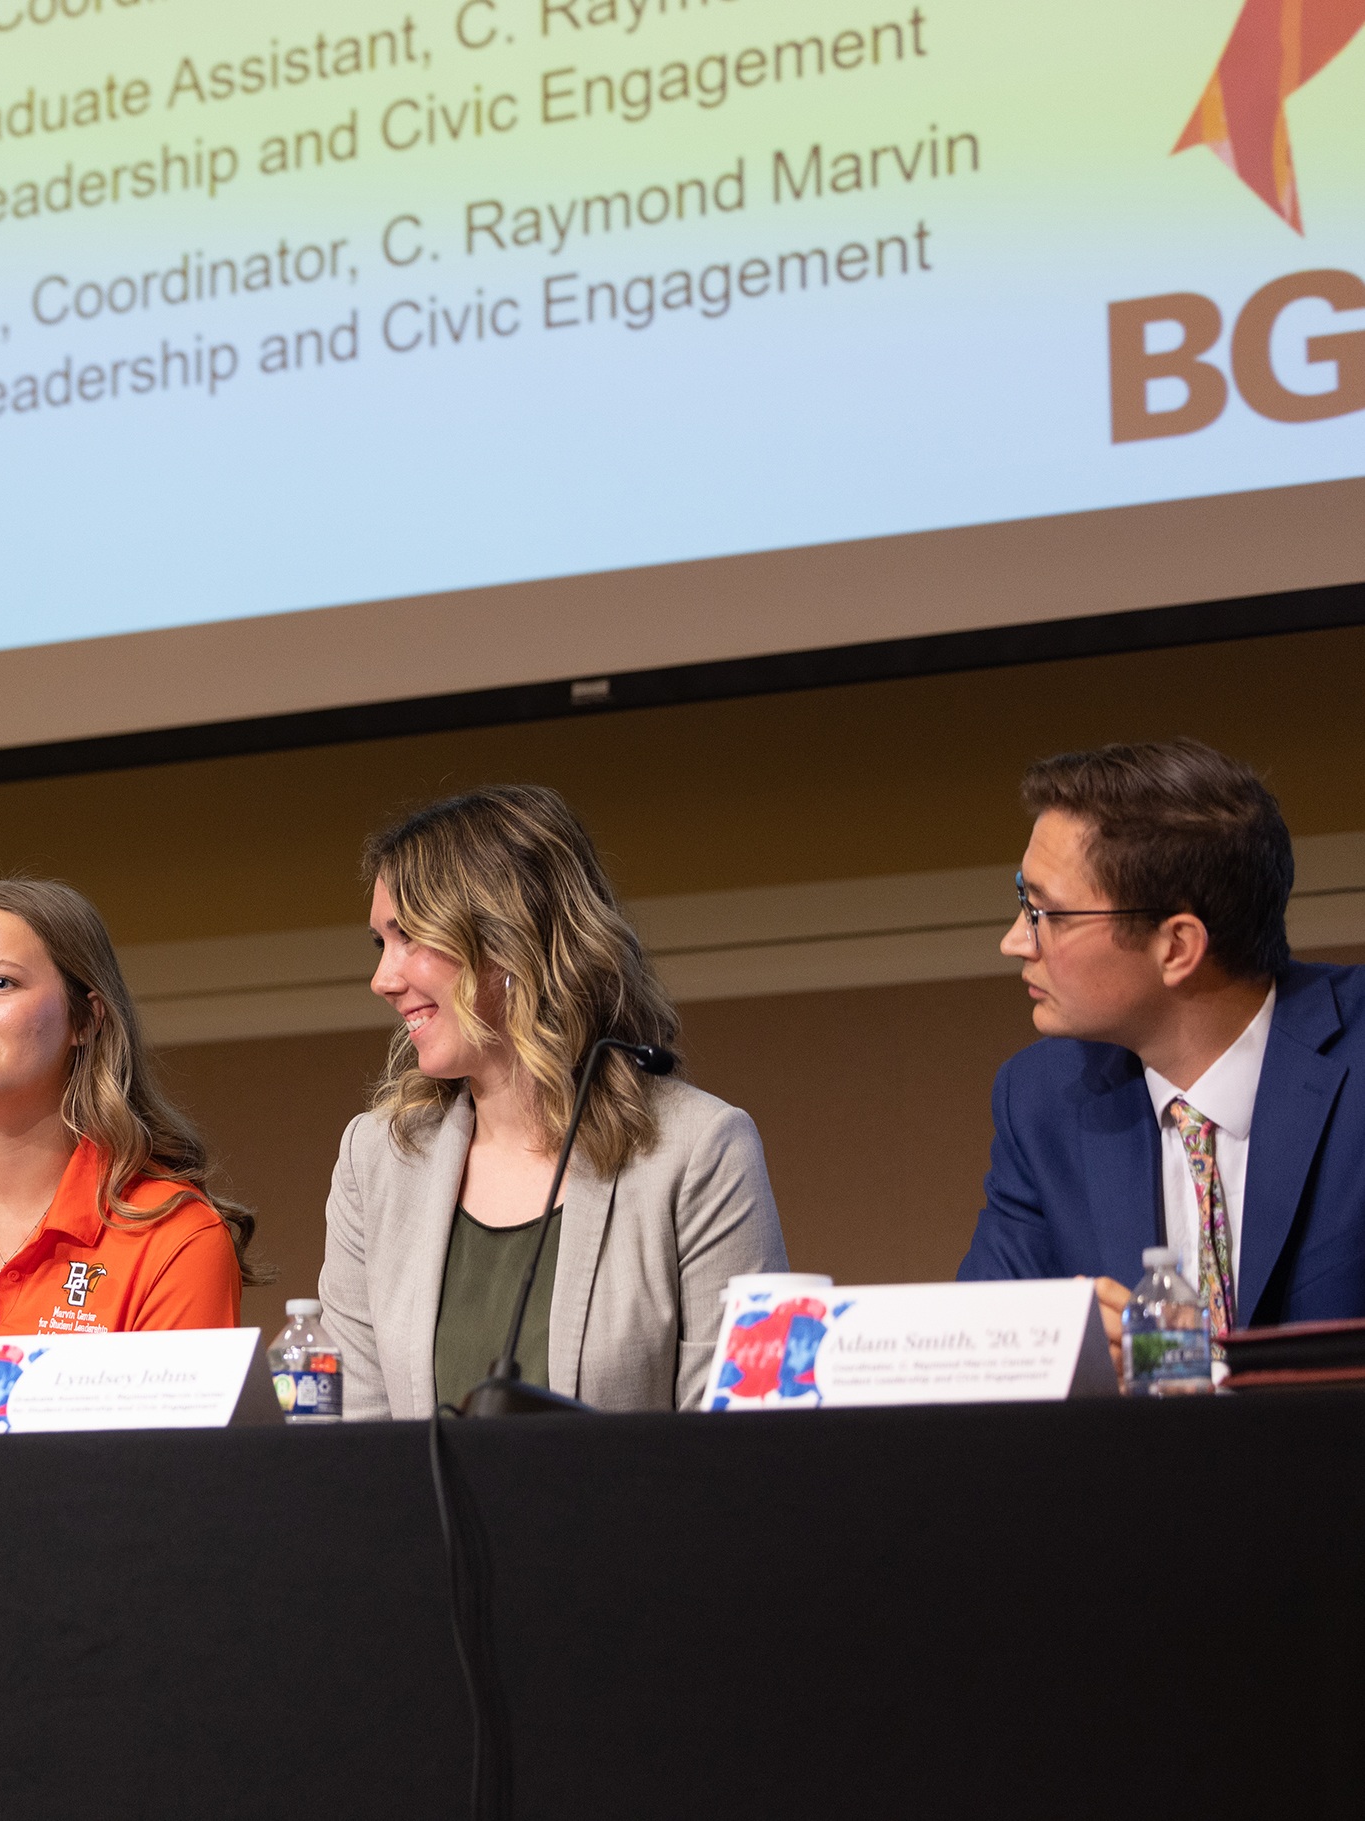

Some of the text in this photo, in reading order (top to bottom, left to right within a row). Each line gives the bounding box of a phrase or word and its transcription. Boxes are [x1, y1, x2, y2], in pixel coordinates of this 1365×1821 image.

[166, 15, 433, 109] Assistant,
[454, 0, 515, 51] C.
[258, 109, 358, 177] and
[380, 84, 519, 153] Civic
[540, 6, 928, 125] Engagement
[31, 238, 359, 328] Coordinator,
[380, 213, 440, 269] C.
[463, 156, 746, 257] Raymond
[771, 123, 981, 205] Marvin
[258, 308, 359, 375] and
[381, 287, 522, 355] Civic
[541, 219, 934, 332] Engagement
[38, 1317, 48, 1328] for
[49, 1318, 74, 1331] Student
[74, 1321, 109, 1333] Leadership
[53, 1306, 97, 1322] Marvin Center
[830, 1334, 898, 1353] Adam
[54, 1368, 198, 1390] Lyndsey Johns
